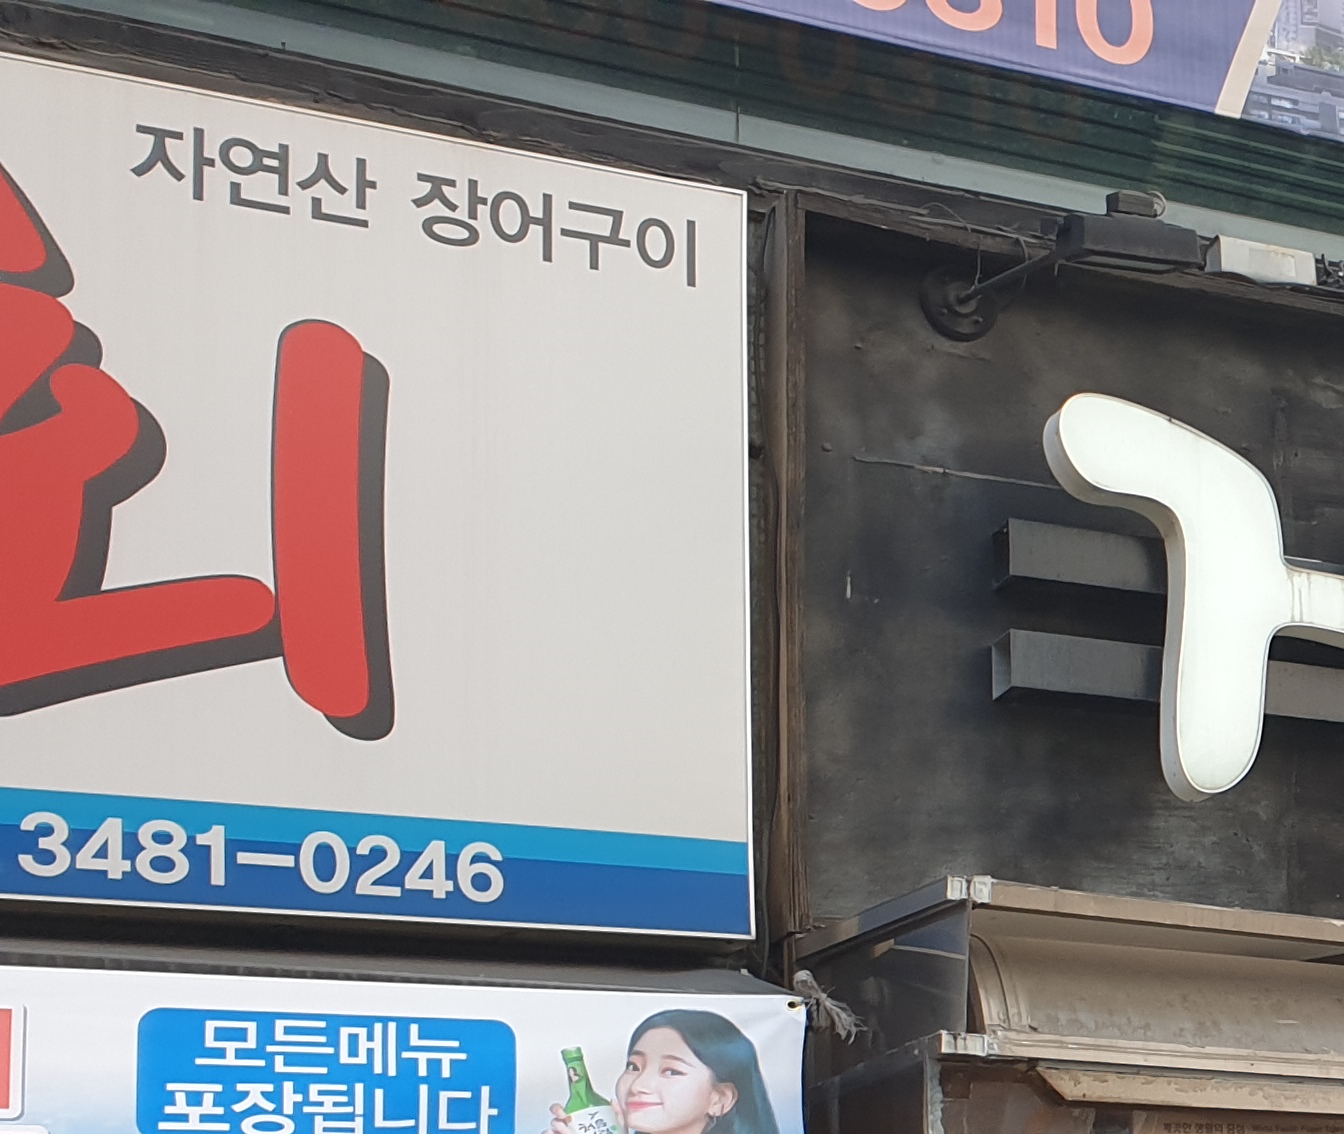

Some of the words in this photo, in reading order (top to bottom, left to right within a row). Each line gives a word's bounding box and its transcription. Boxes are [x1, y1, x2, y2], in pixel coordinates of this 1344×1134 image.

[130, 123, 377, 229] 자연산
[411, 172, 699, 288] 장어구이
[17, 811, 506, 904] 3481-0246
[195, 1017, 468, 1079] 모든메뉴
